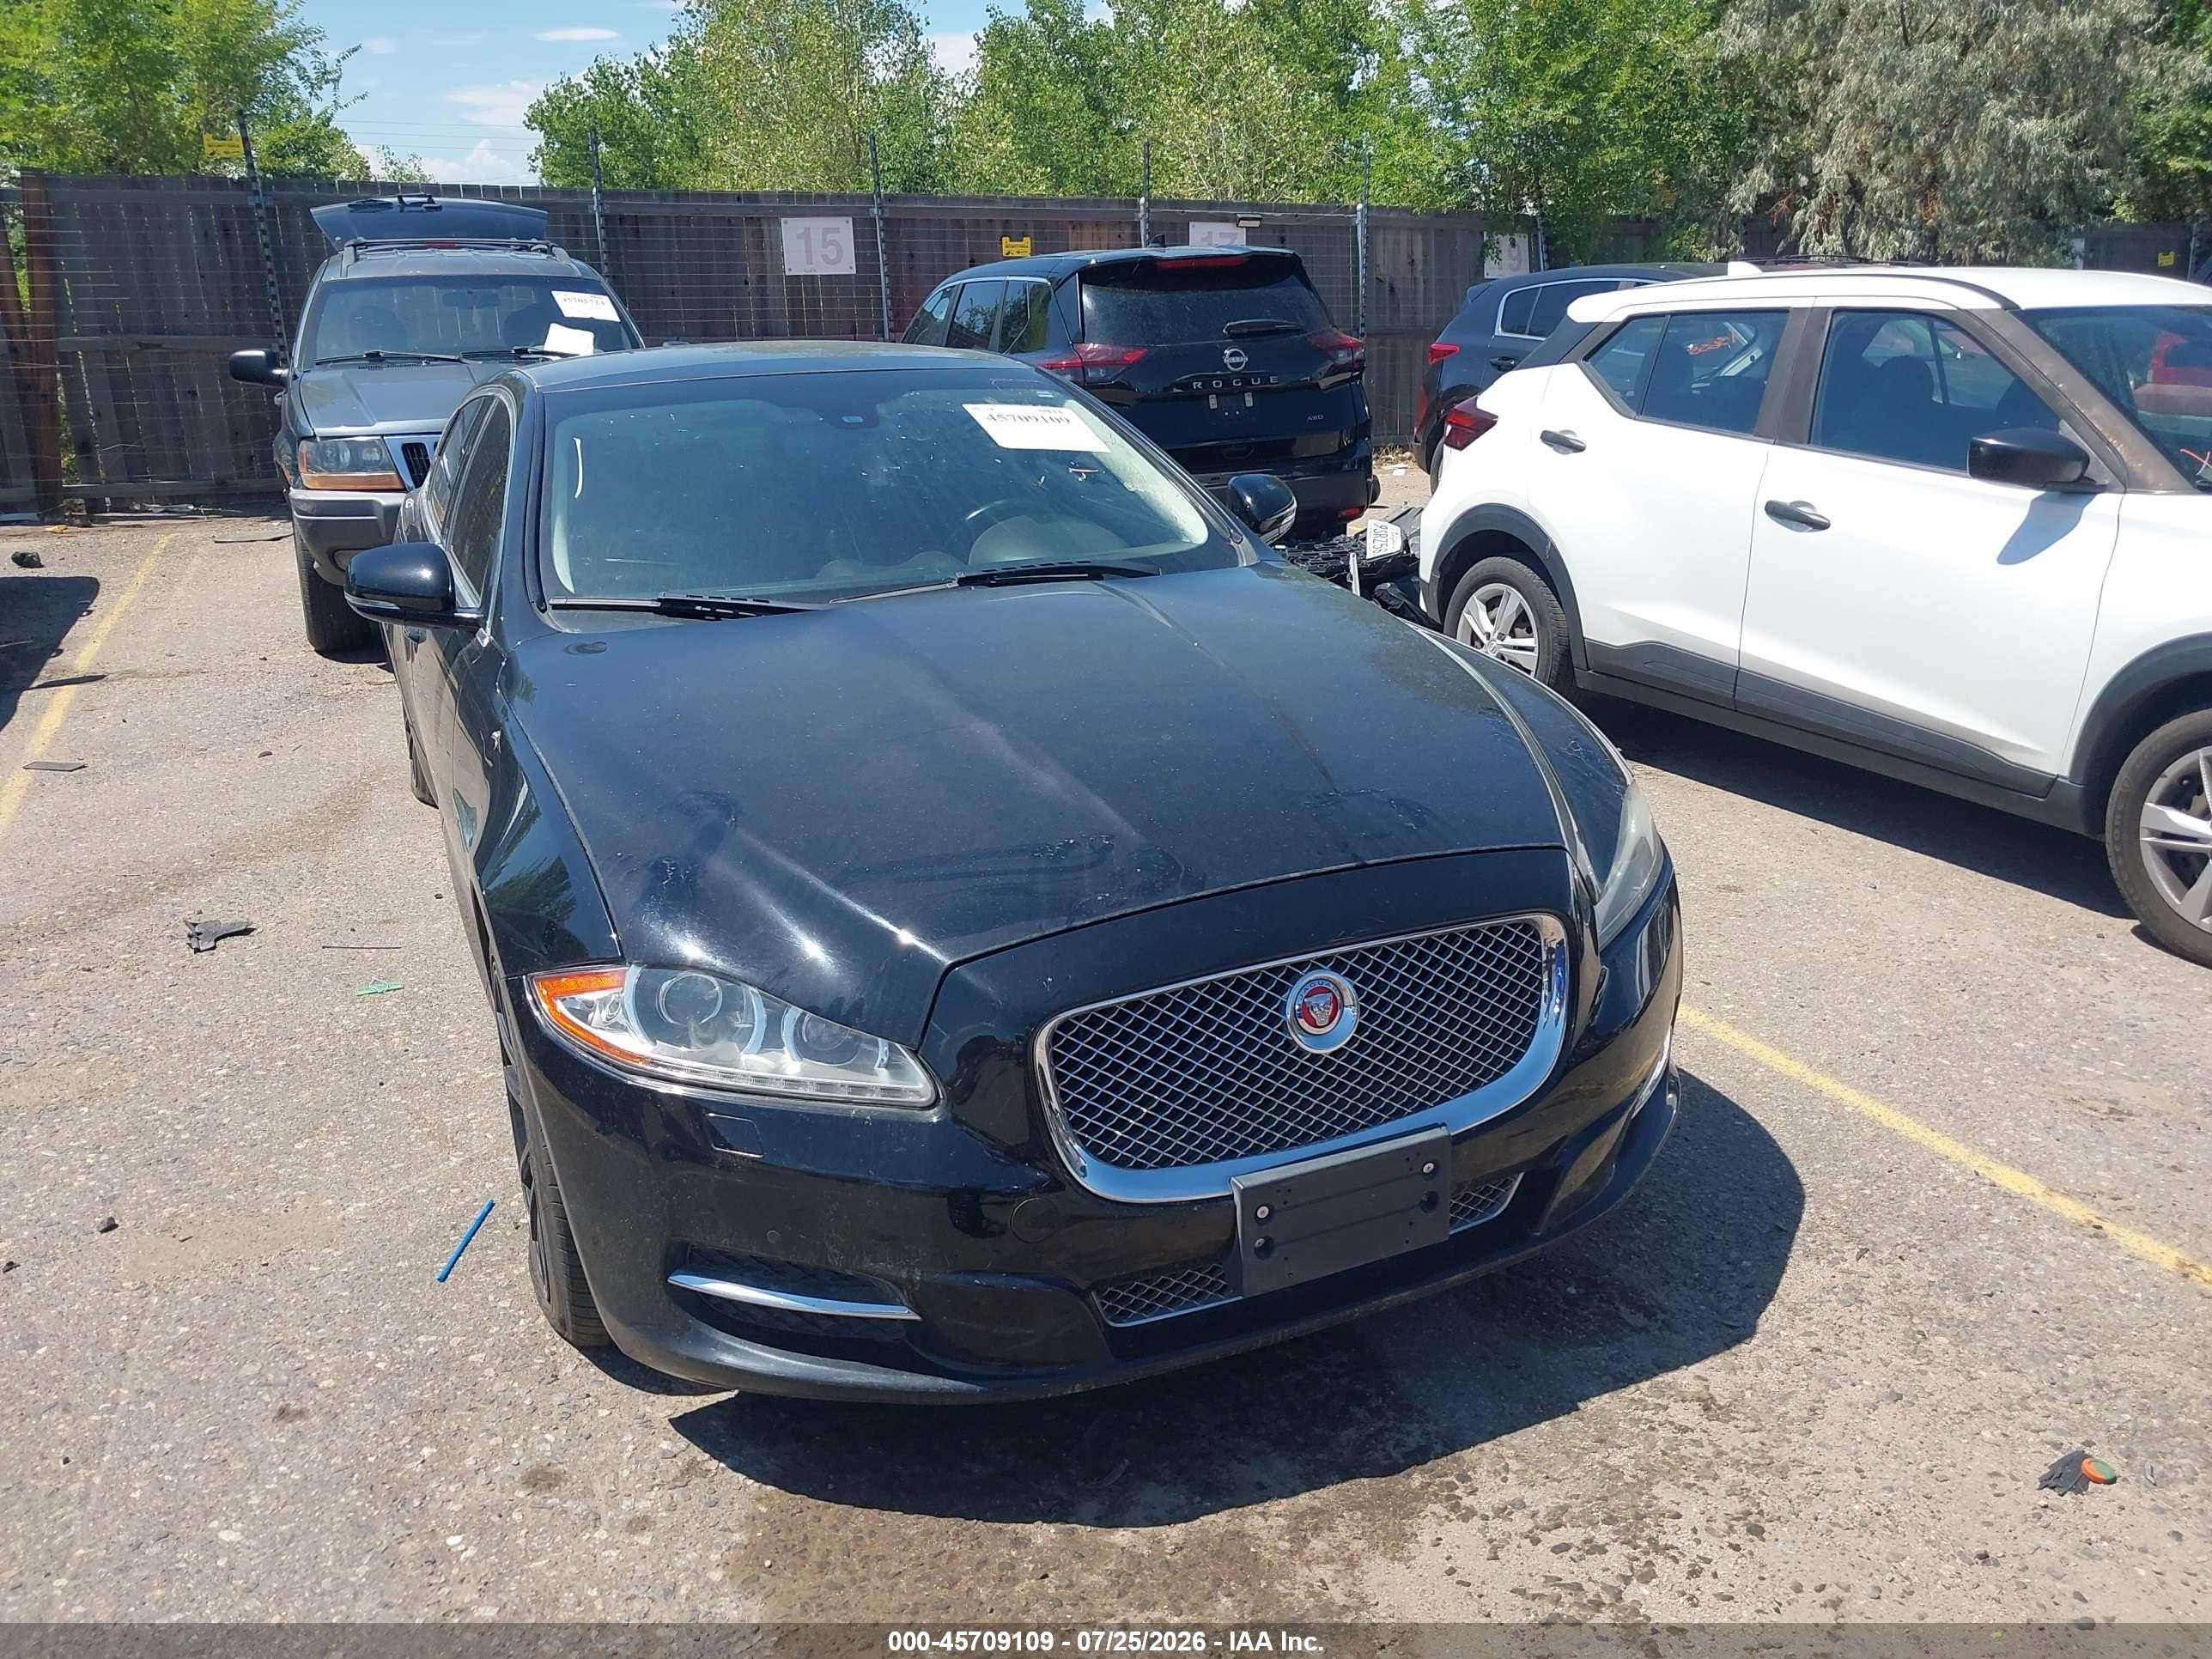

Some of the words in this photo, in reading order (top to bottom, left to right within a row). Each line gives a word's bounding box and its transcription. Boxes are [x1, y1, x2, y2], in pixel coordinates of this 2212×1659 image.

[796, 227, 843, 265] 15
[1193, 375, 1279, 389] ROGUE
[987, 413, 1071, 425] 45709109
[1299, 981, 1339, 1000] JAGUAR
